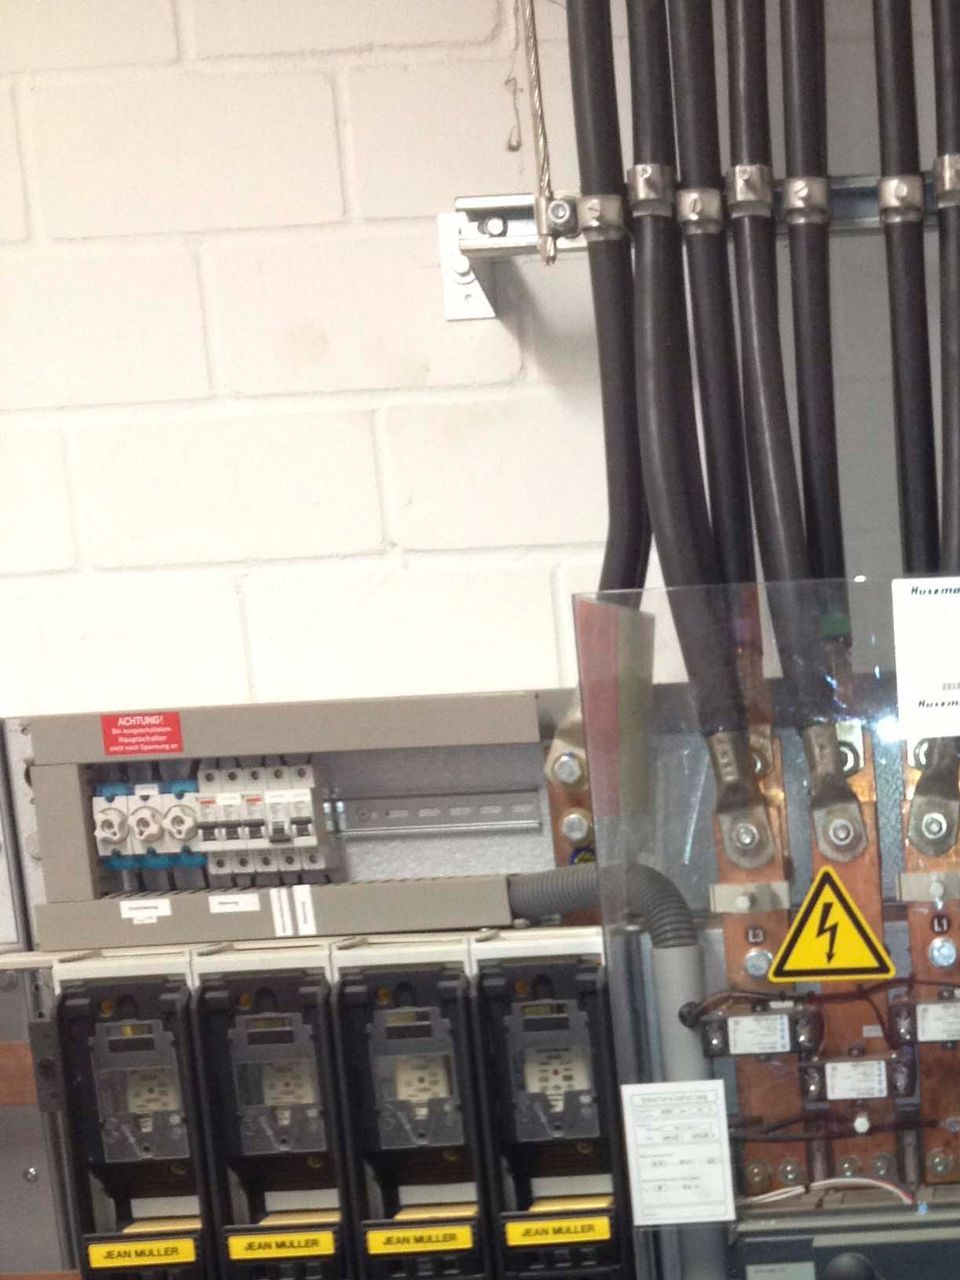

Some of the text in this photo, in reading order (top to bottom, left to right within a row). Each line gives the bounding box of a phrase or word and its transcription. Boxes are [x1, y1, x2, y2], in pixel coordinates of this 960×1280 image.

[934, 918, 948, 932] L1
[522, 1227, 550, 1237] JEAN
[383, 1236, 411, 1246] JEAN
[244, 1241, 273, 1252] JEAN
[103, 1250, 132, 1260] JEAN
